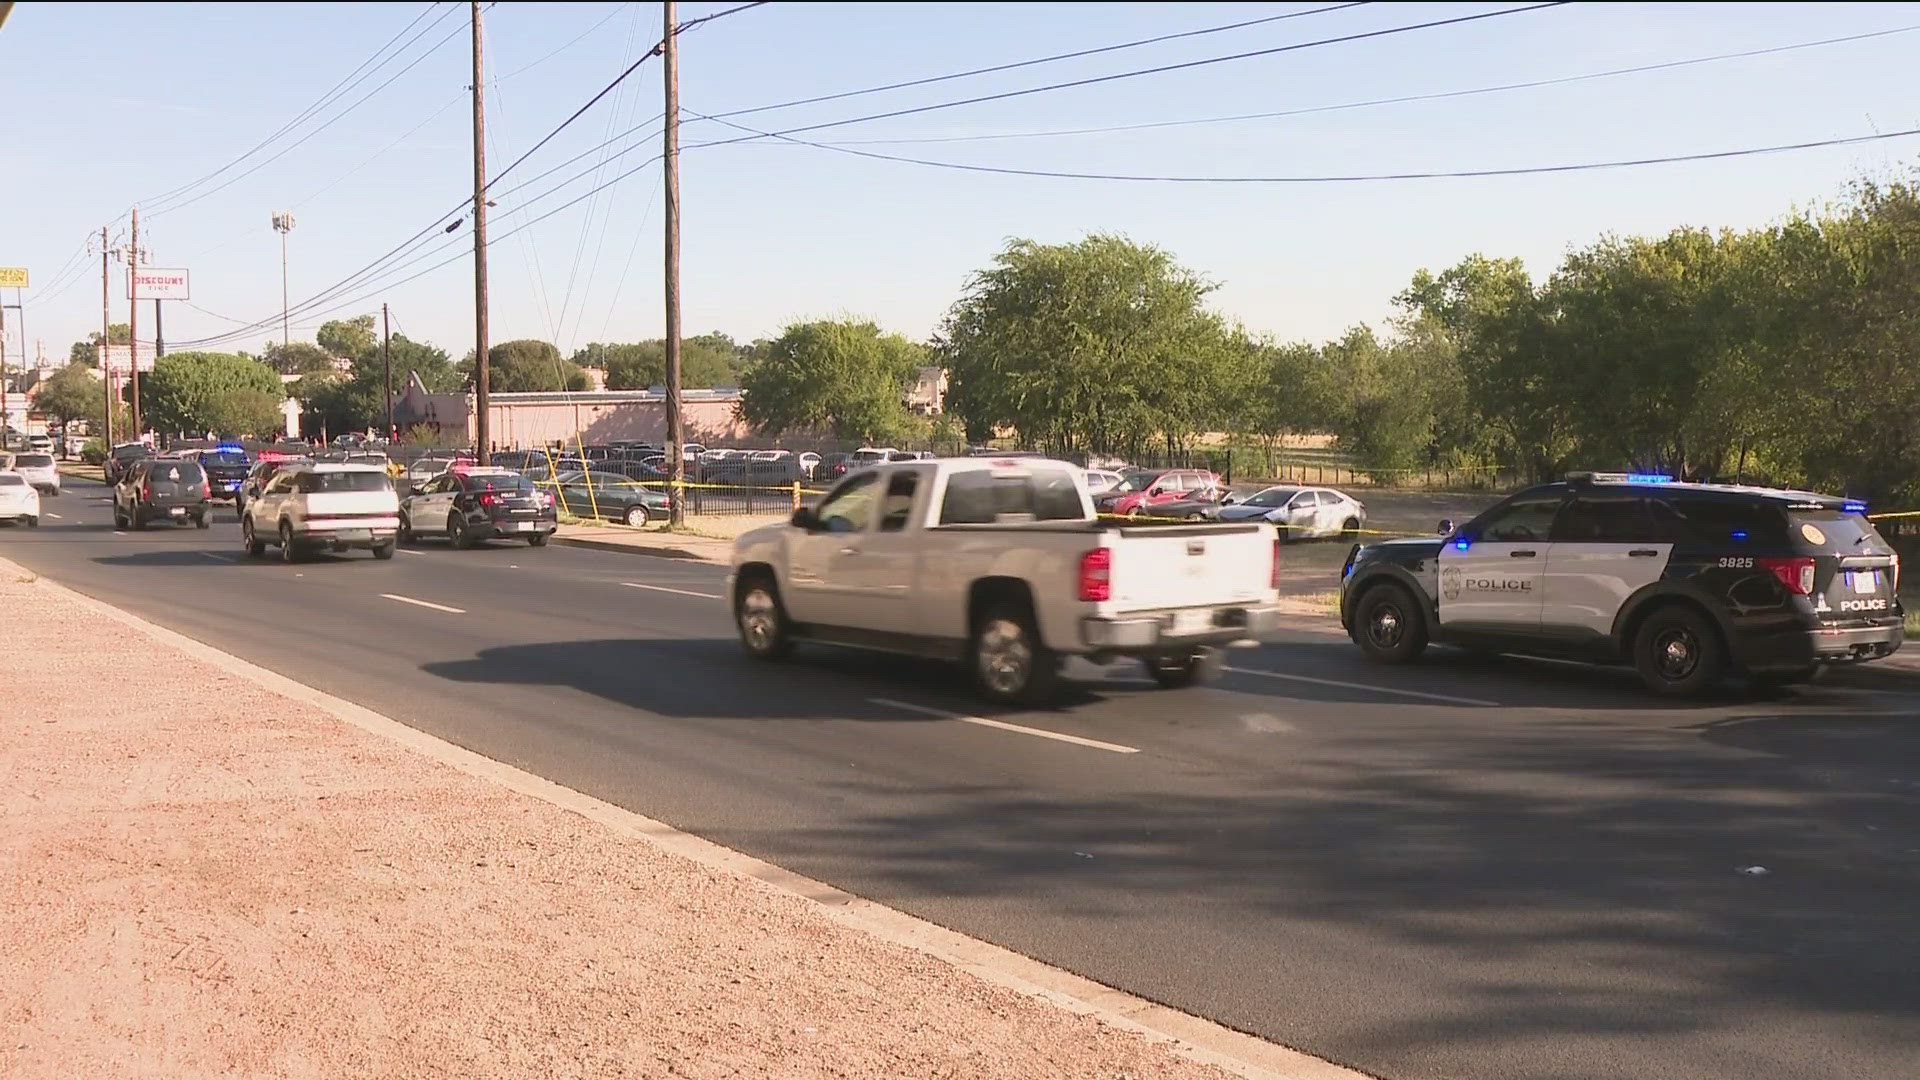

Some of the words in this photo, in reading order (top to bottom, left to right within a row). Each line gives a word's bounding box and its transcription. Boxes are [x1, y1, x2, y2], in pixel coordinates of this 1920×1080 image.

[134, 276, 183, 285] DISCOUNT
[1718, 557, 1754, 568] 3825
[1465, 579, 1532, 590] POLICE
[1840, 599, 1887, 611] POLICE
